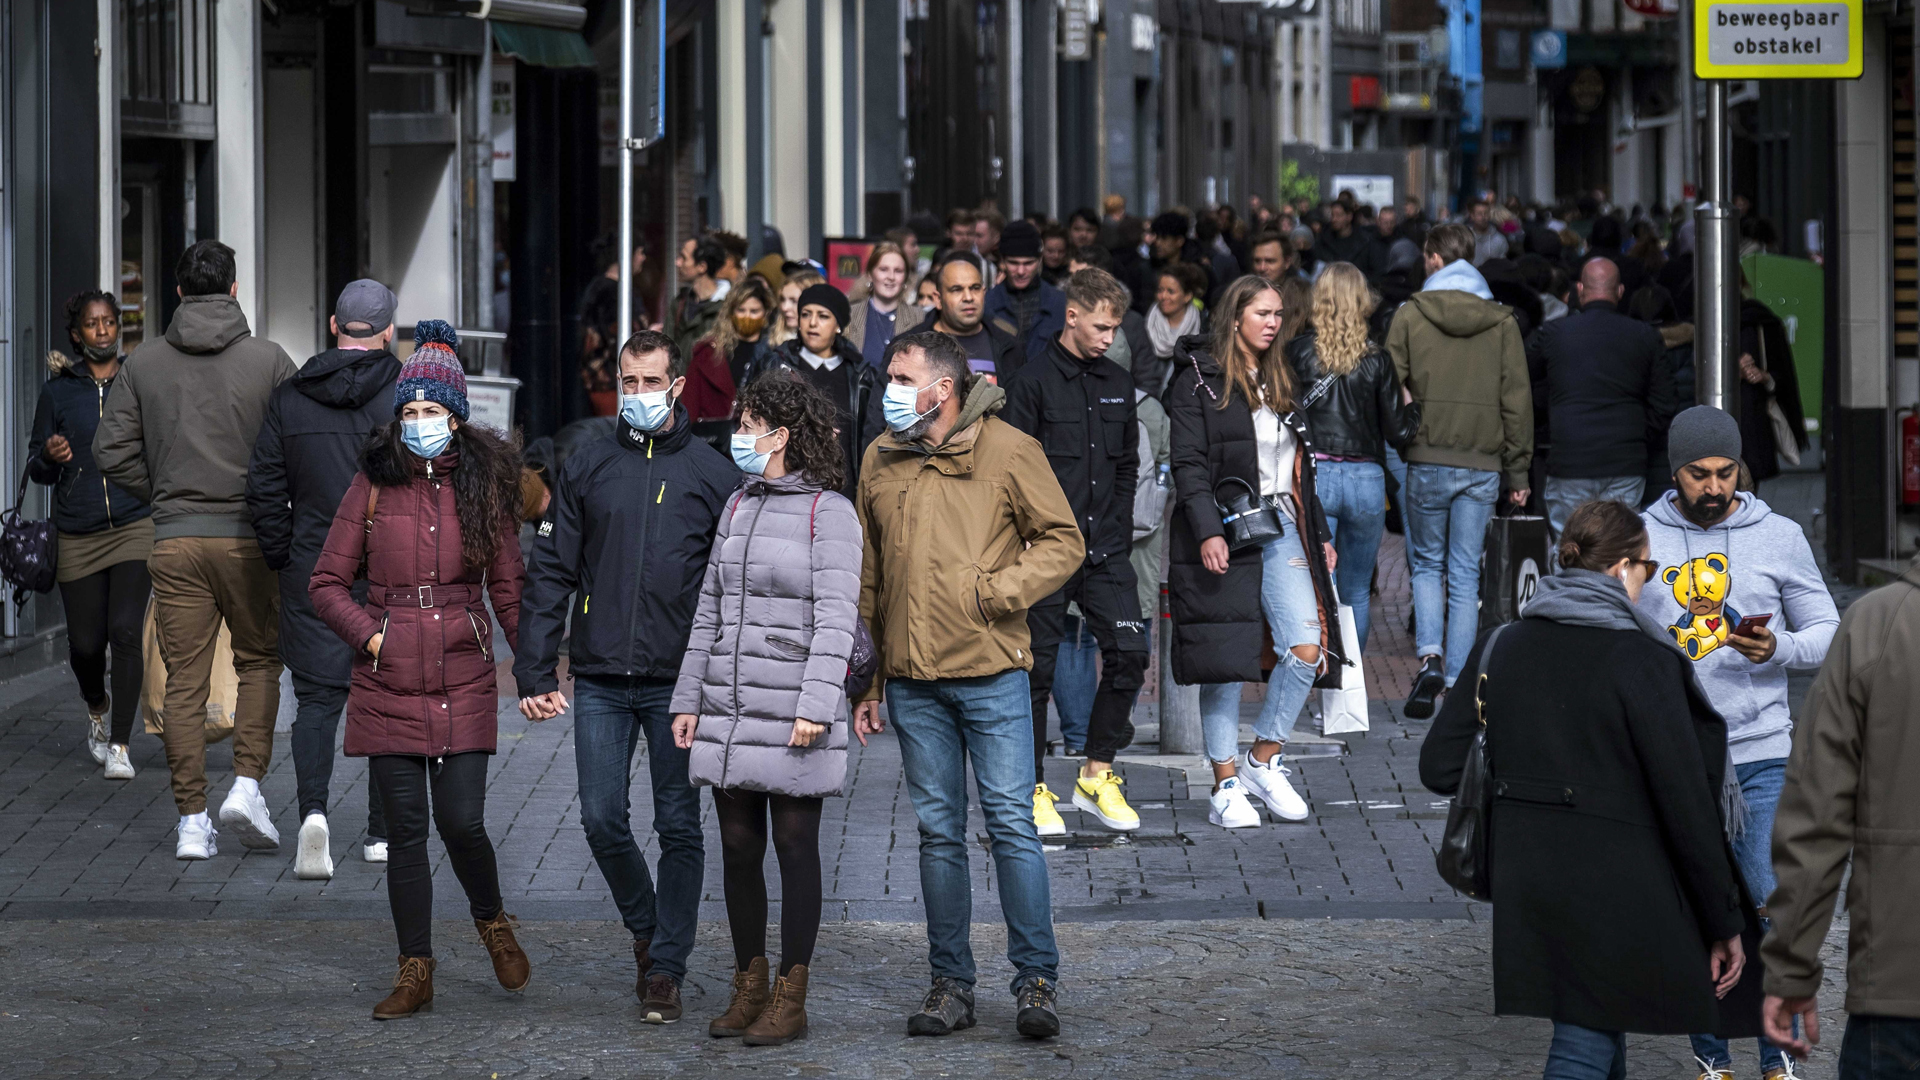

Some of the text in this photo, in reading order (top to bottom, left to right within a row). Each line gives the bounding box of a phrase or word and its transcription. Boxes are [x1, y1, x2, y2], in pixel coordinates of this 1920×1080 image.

[1717, 10, 1840, 30] beweegbaar
[1734, 37, 1821, 54] obstakel
[629, 428, 645, 444] HH
[539, 520, 554, 533] HH
[1519, 573, 1537, 604] JD
